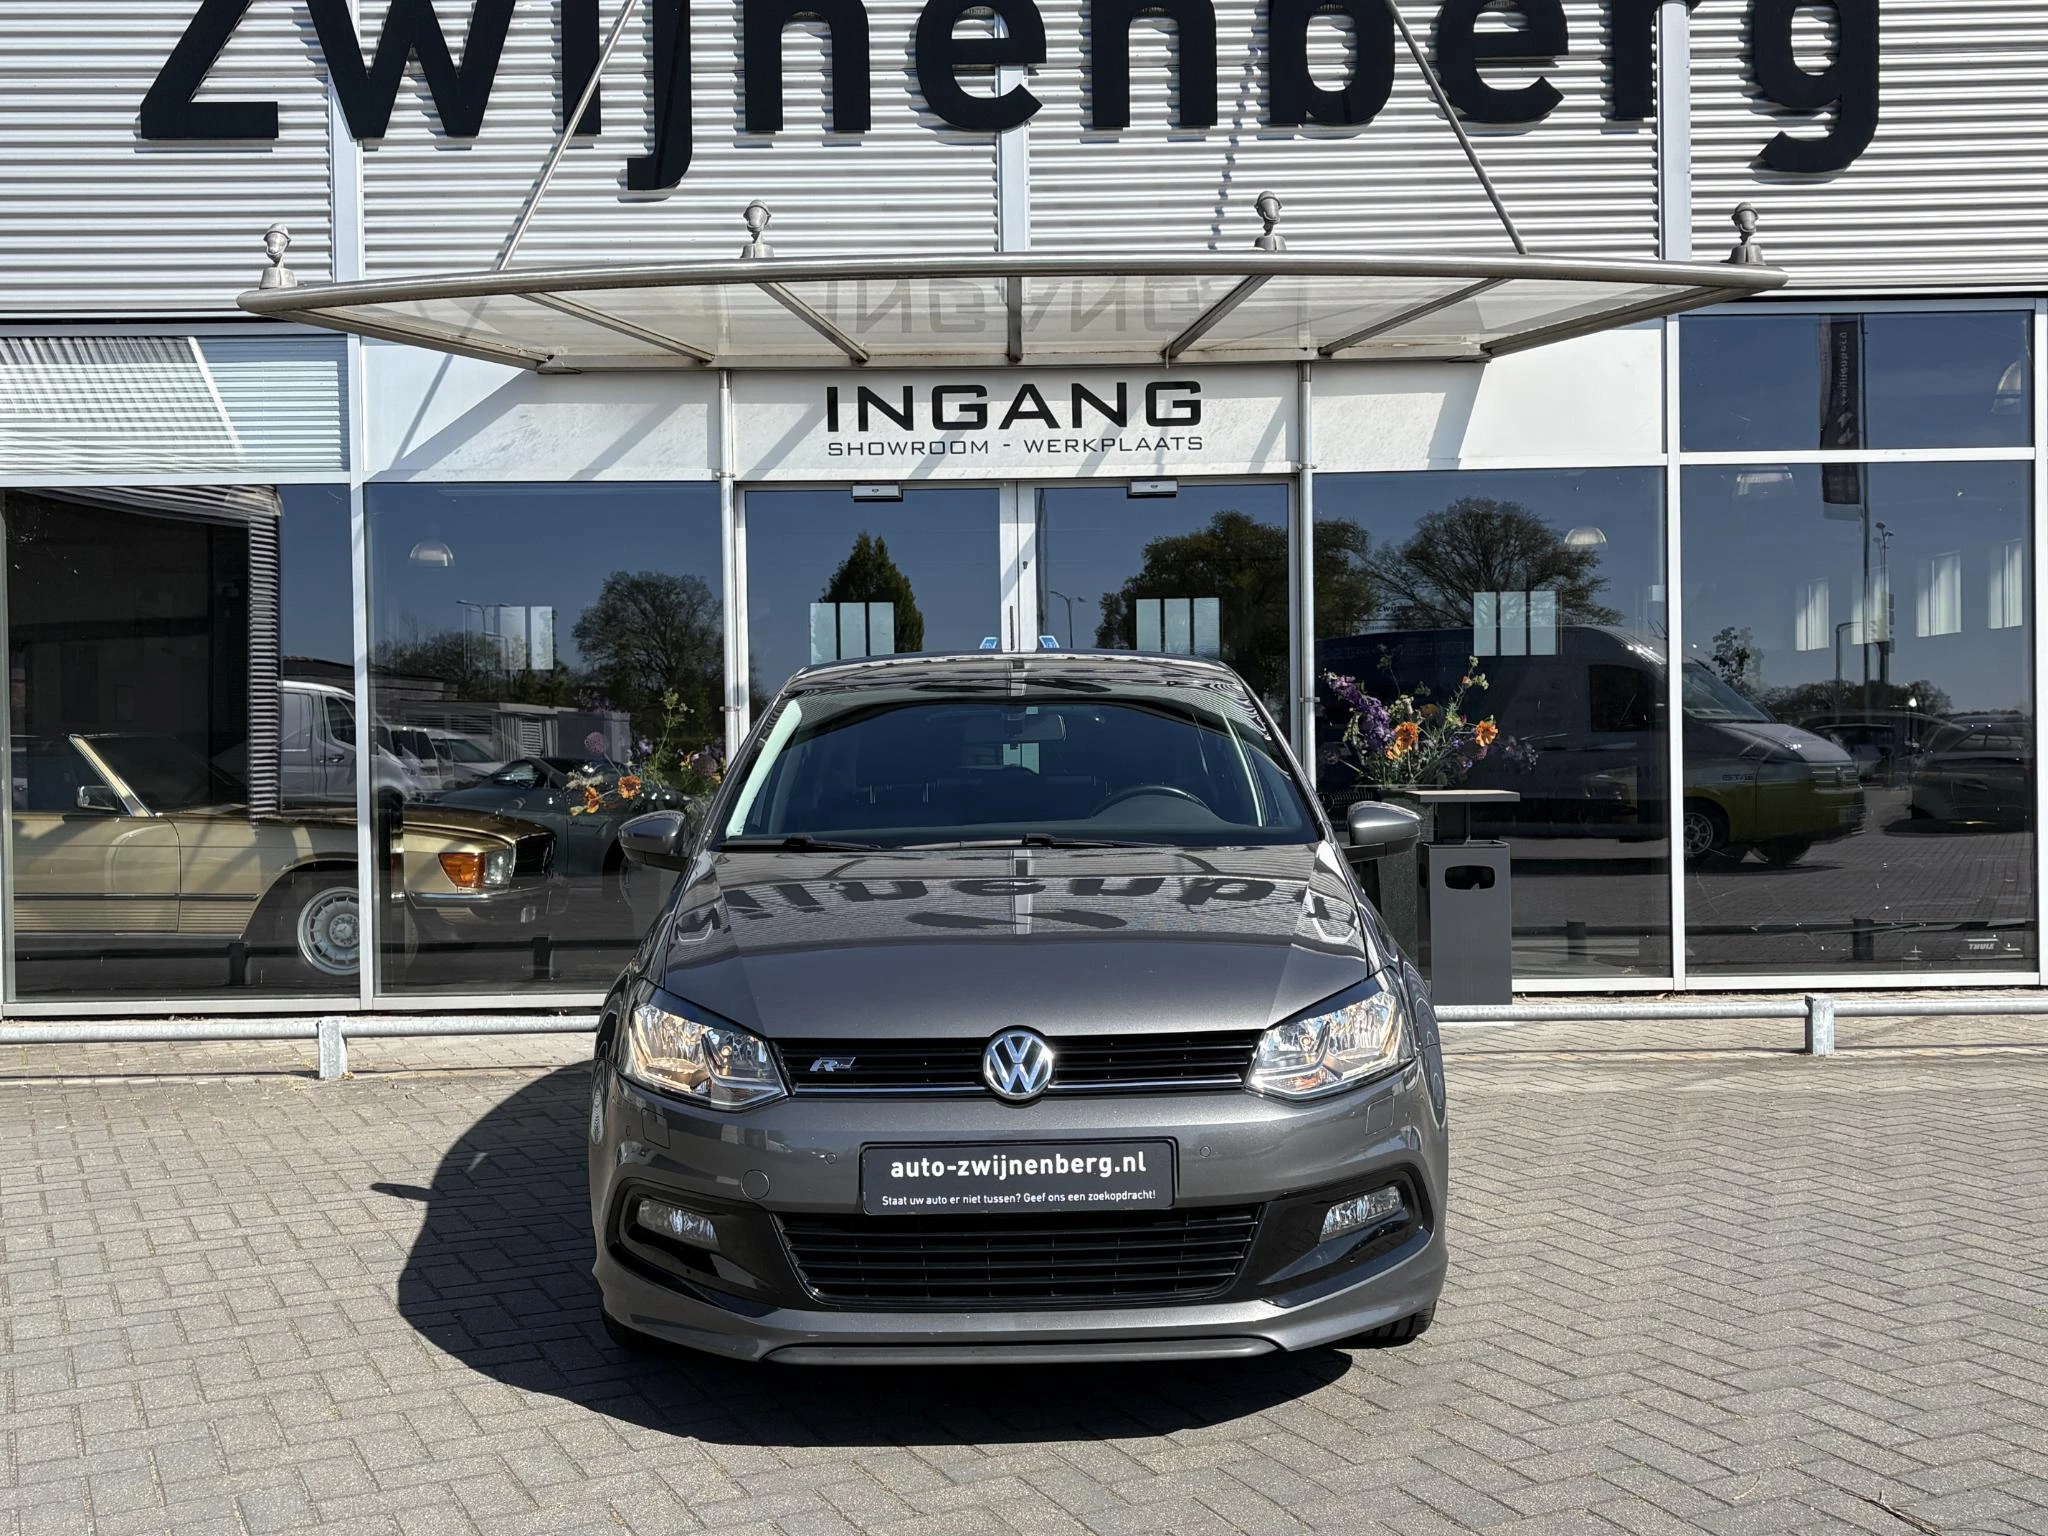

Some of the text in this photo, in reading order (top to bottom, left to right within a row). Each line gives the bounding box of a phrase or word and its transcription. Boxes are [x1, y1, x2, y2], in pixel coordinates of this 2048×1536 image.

[826, 380, 1202, 433] INGANG
[827, 440, 989, 457] SHOWROOM
[1024, 436, 1203, 453] WERKPLAATS
[890, 1151, 1147, 1181] auto-zwijnenberg.nl
[882, 1190, 1156, 1206] Staat uw auto er niet tussen? Geef ons een zoekopdracht!
